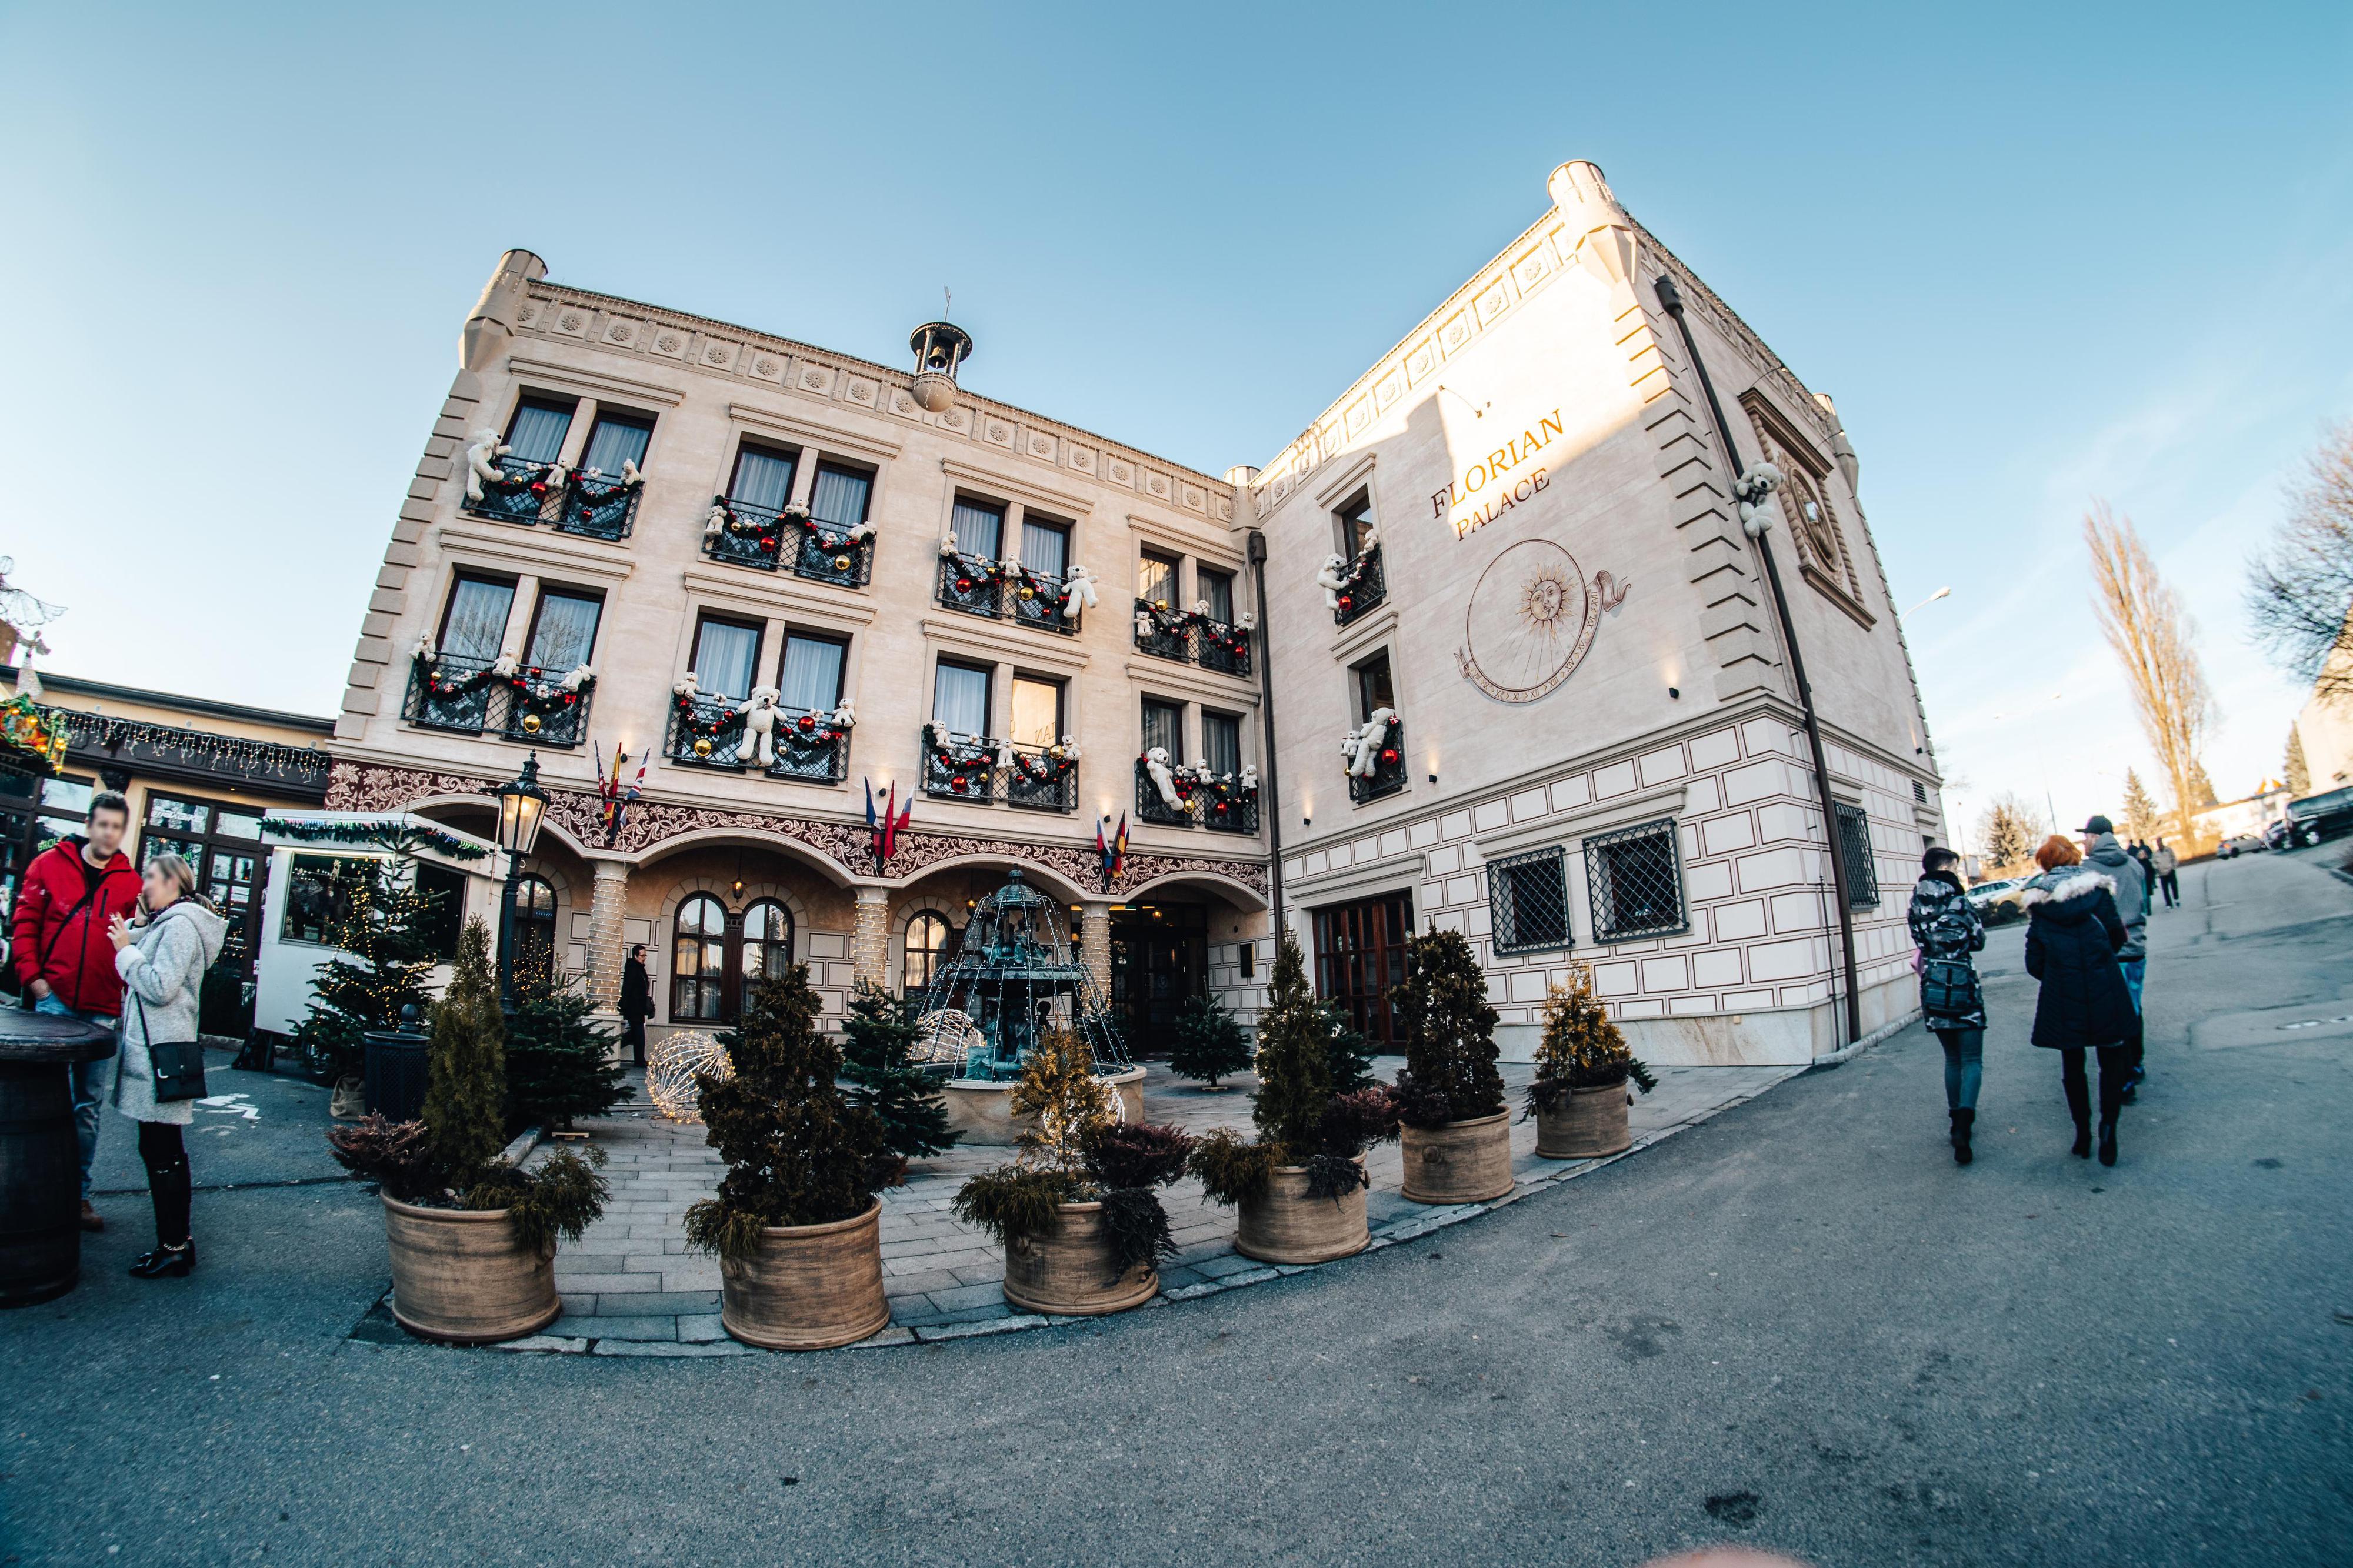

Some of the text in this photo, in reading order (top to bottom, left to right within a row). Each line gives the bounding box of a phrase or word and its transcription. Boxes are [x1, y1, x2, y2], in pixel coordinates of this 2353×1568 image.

[1430, 408, 1564, 520] FLORIAN
[1456, 468, 1550, 542] PALACE
[1512, 693, 1520, 701] XI
[1529, 688, 1541, 699] XII
[1548, 676, 1559, 688] XIII
[1565, 658, 1575, 672] XIV
[1577, 640, 1585, 653] XV
[1586, 616, 1595, 629] XVI
